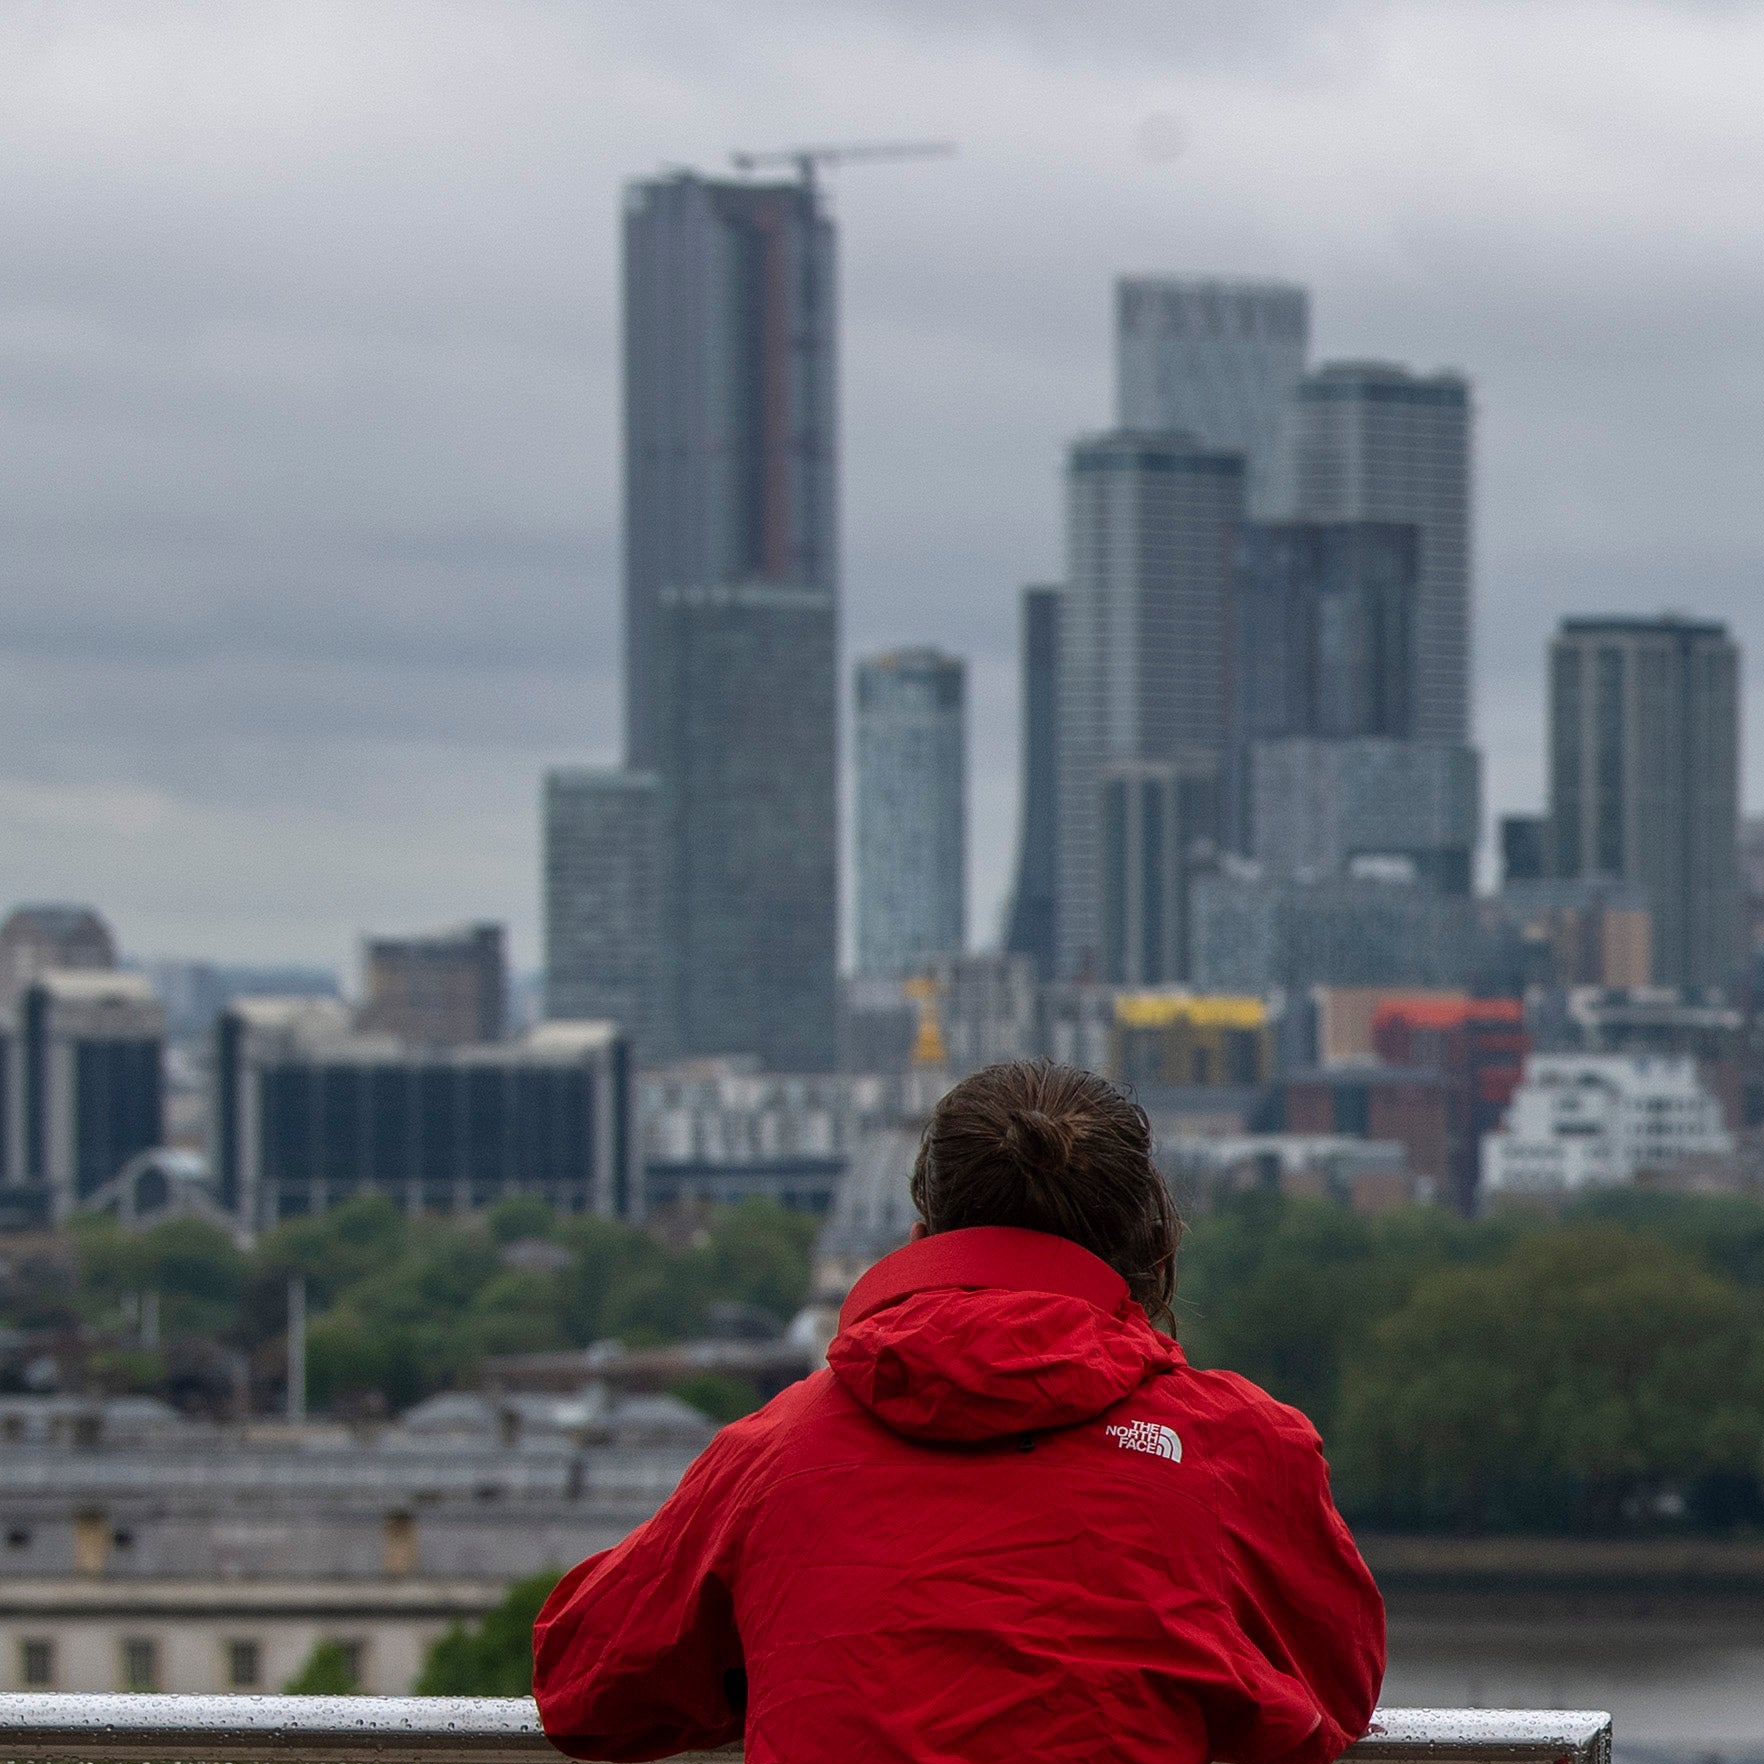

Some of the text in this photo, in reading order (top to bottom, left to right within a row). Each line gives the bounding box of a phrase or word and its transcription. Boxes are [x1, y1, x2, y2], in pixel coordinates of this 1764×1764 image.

[1105, 1425, 1159, 1444] NORTH
[1131, 1420, 1160, 1434] THE
[1118, 1437, 1156, 1455] FACE
